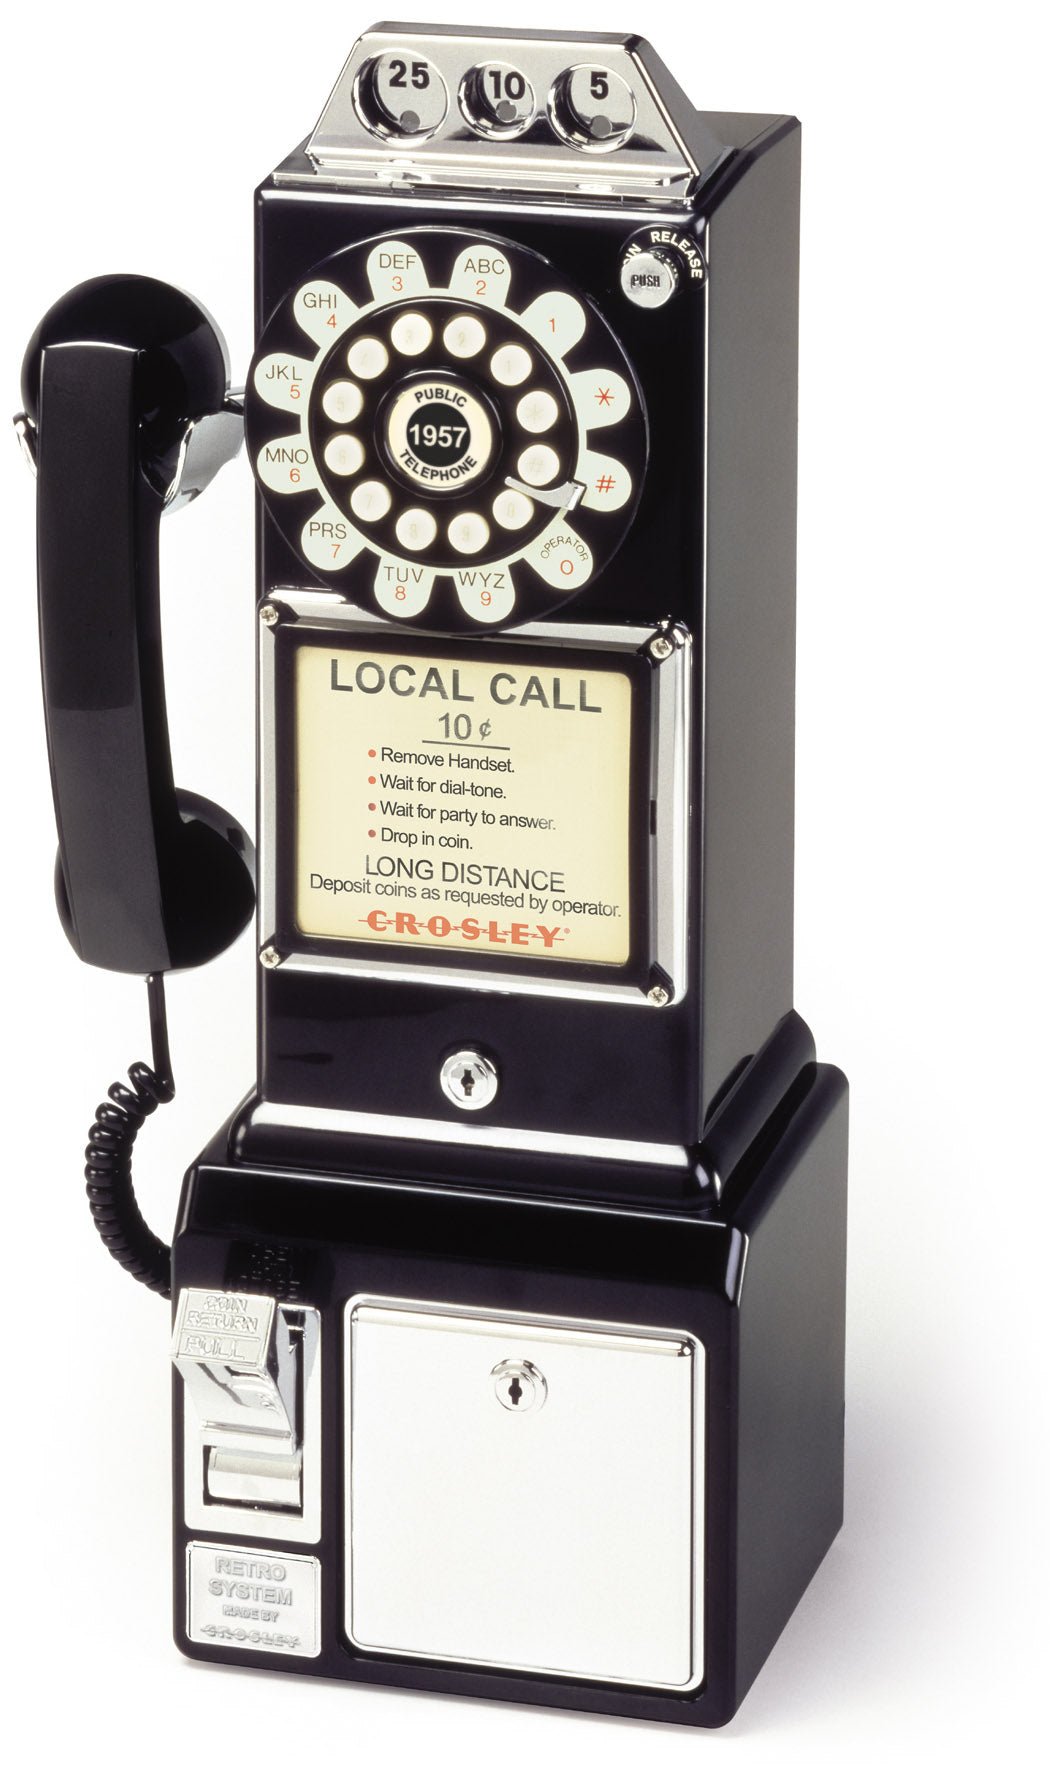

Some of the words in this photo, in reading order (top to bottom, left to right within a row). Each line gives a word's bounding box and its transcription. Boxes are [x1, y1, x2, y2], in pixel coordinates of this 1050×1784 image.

[389, 59, 430, 90] 25
[489, 70, 526, 100] 10
[590, 72, 609, 100] 5
[379, 253, 417, 270] DEF
[650, 231, 703, 279] RELEASE
[464, 258, 505, 275] ABC
[392, 276, 403, 292] 3
[476, 280, 486, 296] 2
[630, 274, 660, 288] PUSH
[303, 292, 338, 310] GHI
[327, 314, 337, 329] 4
[549, 318, 556, 333] 1
[266, 364, 303, 382] JKL
[290, 384, 301, 400] 5
[414, 387, 468, 408] PUBLIC
[409, 423, 467, 449] 1957
[265, 447, 309, 465] MNO
[400, 448, 477, 481] TELEPHONE
[289, 468, 301, 483] 6
[309, 522, 347, 540] PRS
[331, 544, 341, 559] 7
[541, 535, 589, 562] OPERATOR
[384, 566, 424, 584] TUV
[459, 571, 505, 590] WYZ
[395, 586, 406, 602] 8
[480, 591, 492, 607] 9
[330, 658, 474, 702] LOCAL
[489, 672, 602, 713] CALL
[438, 712, 472, 741] 10
[380, 747, 444, 768] Remove
[448, 753, 515, 774] Handset.
[380, 774, 414, 792] Wait
[416, 778, 436, 794] for
[439, 780, 507, 800] dial-tone.
[380, 801, 414, 818] Wait
[416, 804, 436, 820] for
[440, 809, 478, 827] party
[481, 812, 496, 826] to
[499, 816, 557, 832] answer.
[381, 828, 418, 848] Drop
[422, 832, 435, 846] in
[438, 835, 473, 851] coin.
[365, 855, 434, 880] LONG
[442, 861, 566, 893] DISTANCE
[310, 873, 371, 897] Deposit
[375, 881, 416, 899] coins
[421, 886, 440, 901] as
[444, 890, 524, 909] requested
[529, 896, 548, 913] by
[552, 899, 622, 918] operator.
[187, 1311, 259, 1334] RETURN
[184, 1336, 246, 1360] PULL
[215, 1556, 287, 1582] RETRO
[208, 1578, 293, 1606] SYSTEM
[222, 1604, 259, 1620] MADE
[261, 1609, 279, 1623] BY
[200, 1624, 301, 1649] CROSLEY
